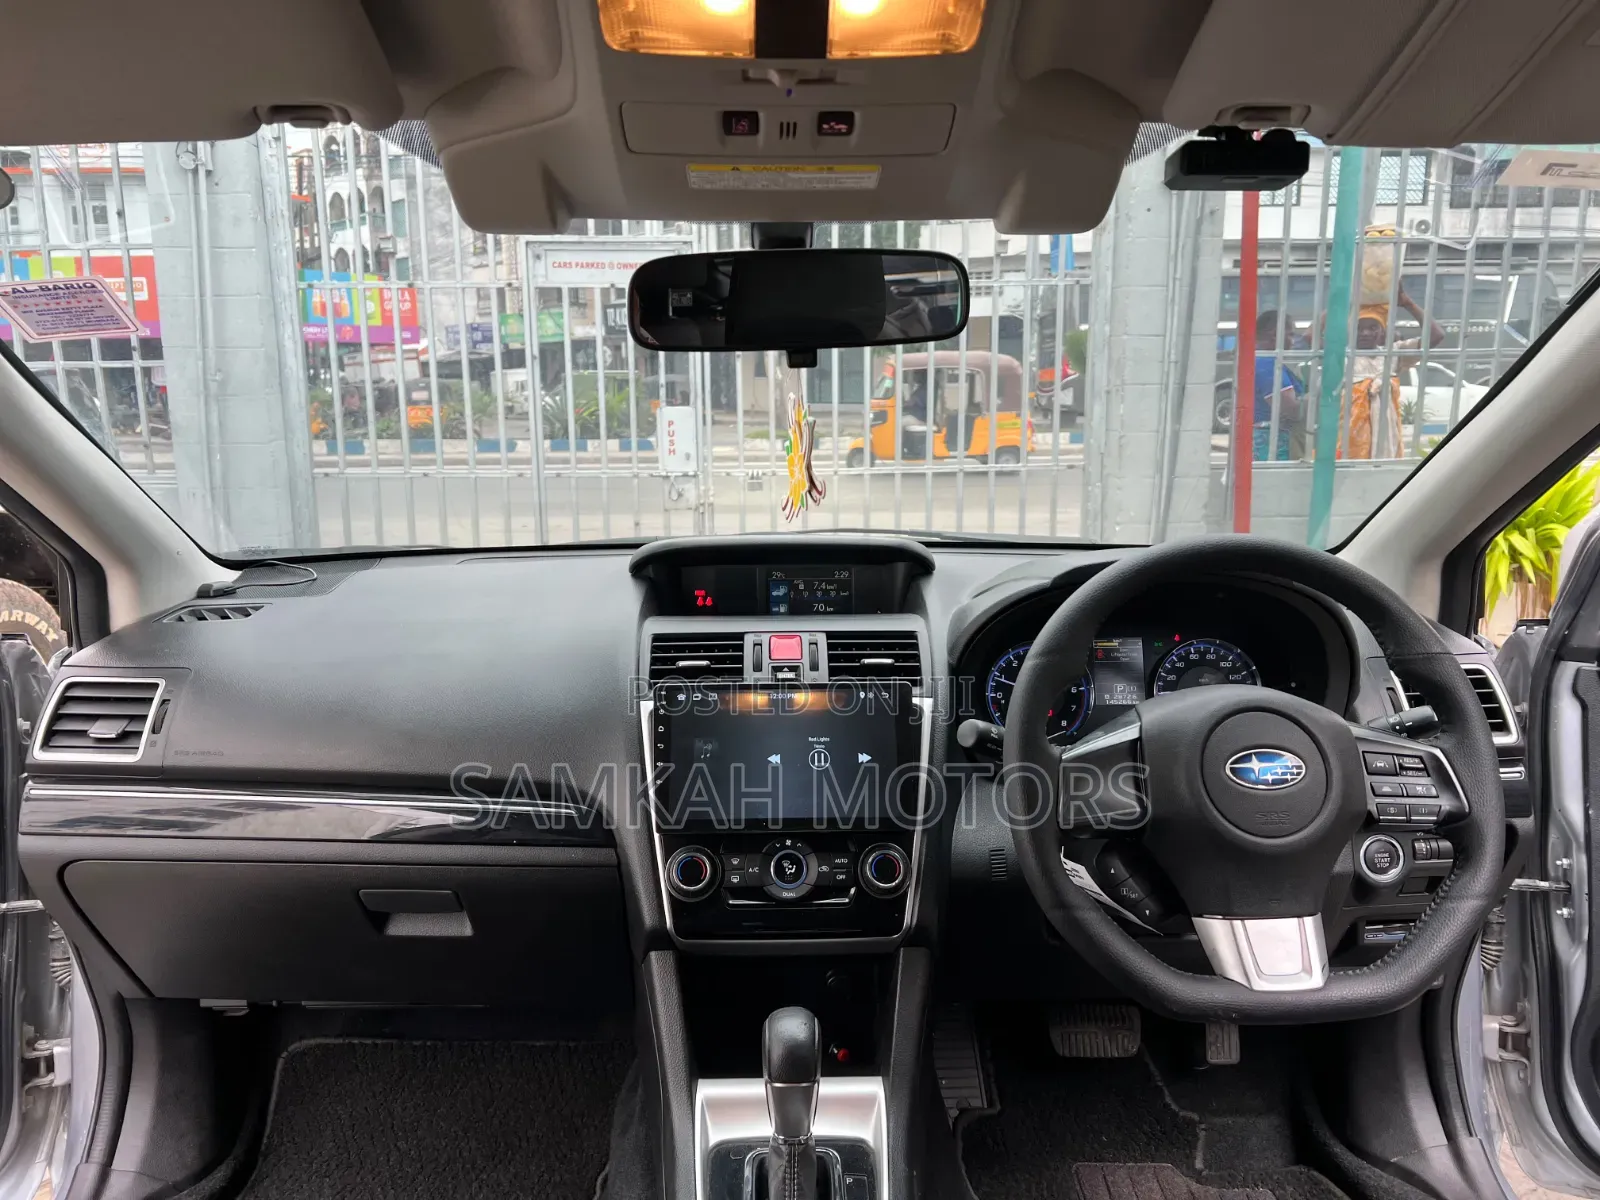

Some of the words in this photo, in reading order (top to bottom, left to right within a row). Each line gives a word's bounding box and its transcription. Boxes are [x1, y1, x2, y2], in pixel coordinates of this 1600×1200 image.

[552, 261, 573, 269] CARS
[575, 261, 606, 269] PARKED
[616, 262, 642, 270] OWNE
[11, 281, 97, 294] AL-BARIQ
[12, 292, 59, 300] INSURANCE
[667, 420, 676, 456] PUSH
[813, 581, 826, 590] 7.4
[812, 603, 825, 612] 70
